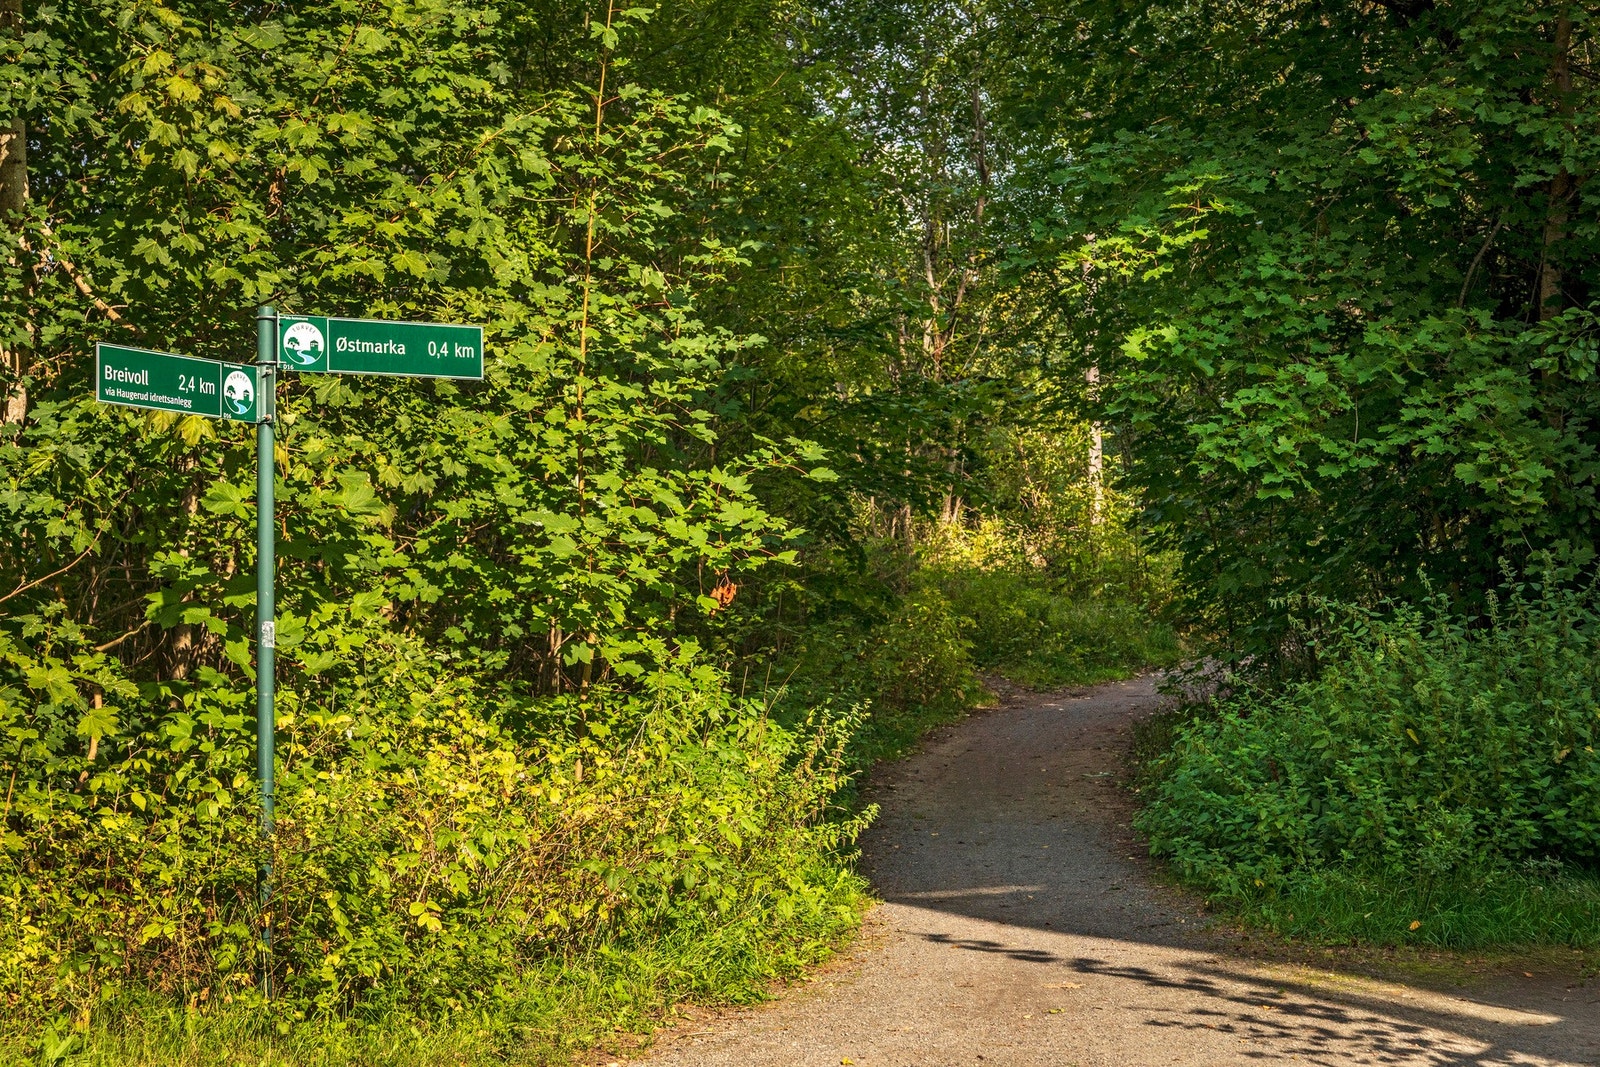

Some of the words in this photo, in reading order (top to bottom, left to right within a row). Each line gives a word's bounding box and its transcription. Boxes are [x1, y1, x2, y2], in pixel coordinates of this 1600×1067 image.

[336, 337, 406, 355] Østmarka
[428, 341, 449, 359] 0,4
[455, 342, 475, 358] km
[104, 365, 149, 386] Breivoll
[178, 374, 195, 393] 2,4
[199, 377, 215, 395] km
[105, 387, 116, 397] via
[116, 388, 149, 401] Haugerud
[149, 392, 192, 408] idrettsanlegg
